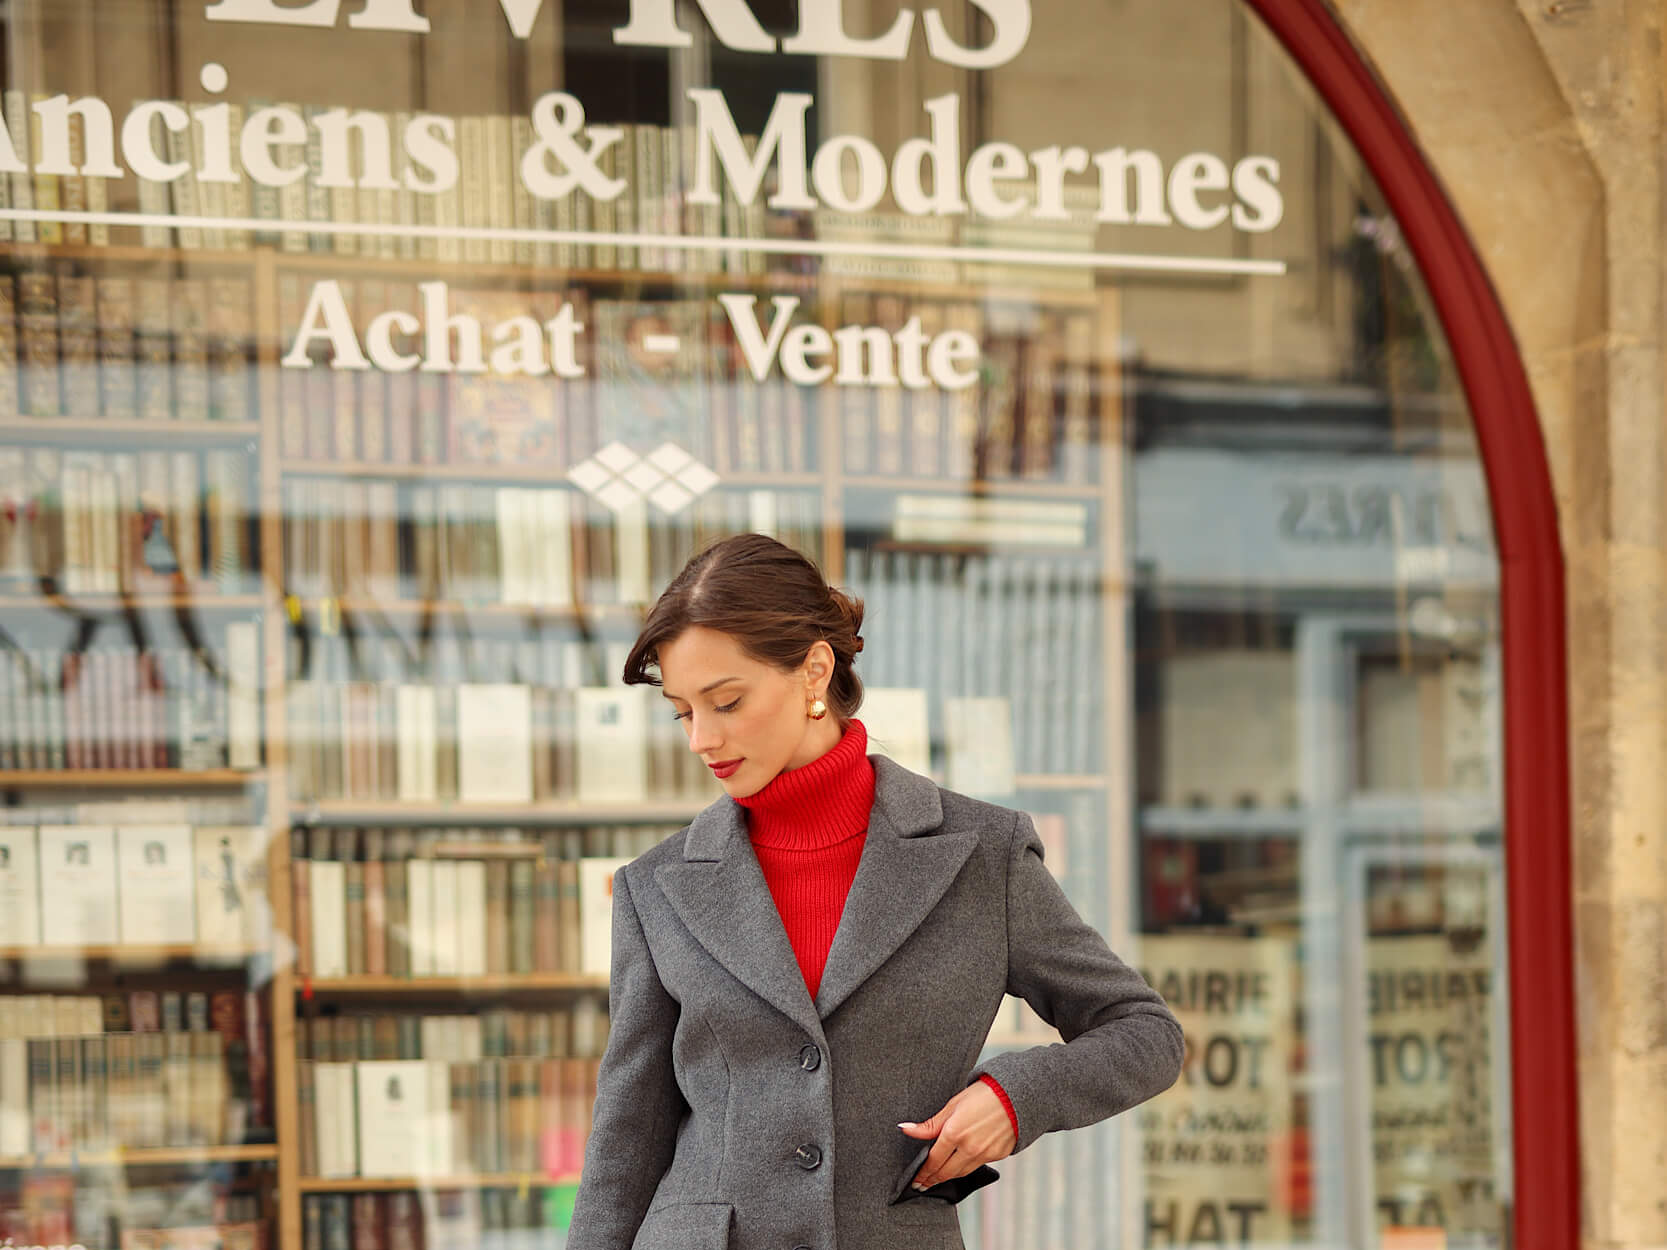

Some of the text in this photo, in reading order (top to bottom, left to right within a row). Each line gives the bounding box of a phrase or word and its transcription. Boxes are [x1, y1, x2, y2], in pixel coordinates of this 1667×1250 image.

[0, 62, 1284, 233] nciens & Modernes
[281, 280, 586, 378] Achat
[718, 293, 981, 390] Vente
